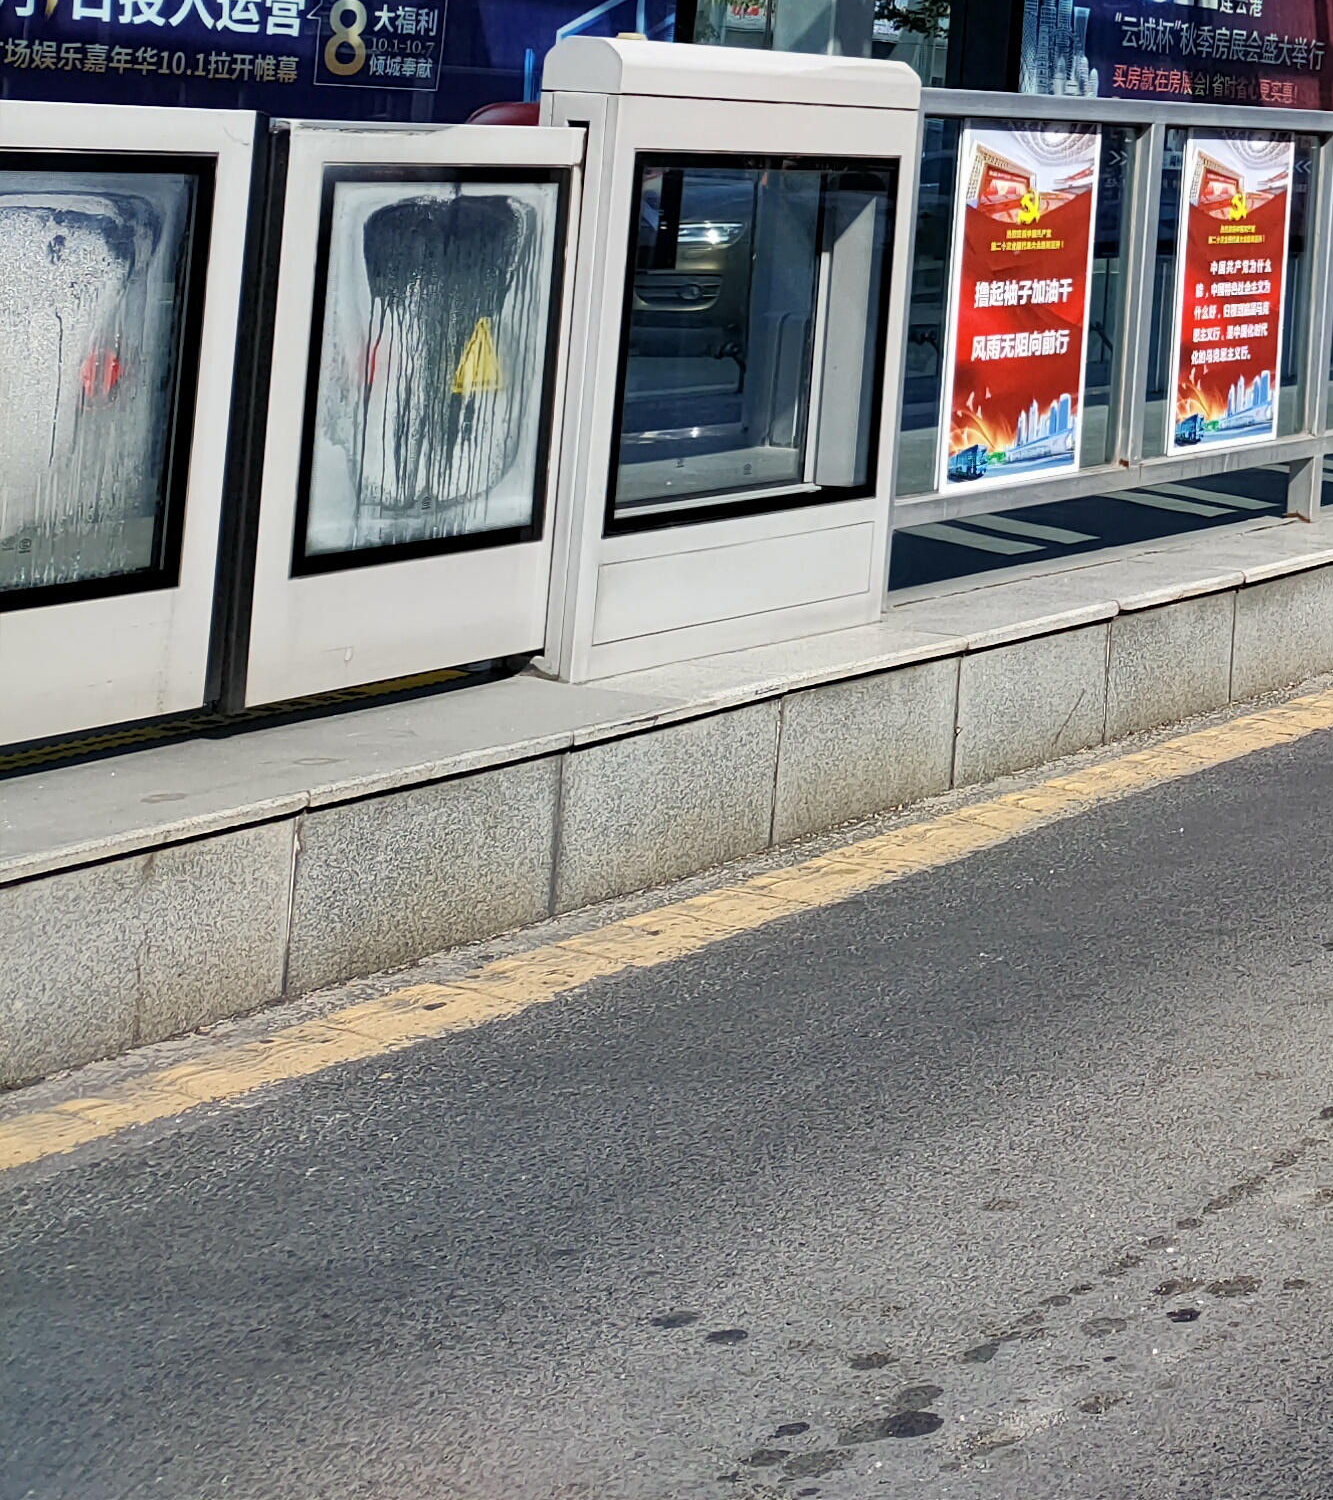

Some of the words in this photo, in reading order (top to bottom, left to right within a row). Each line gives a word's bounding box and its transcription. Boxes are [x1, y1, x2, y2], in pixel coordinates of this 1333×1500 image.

[372, 4, 439, 37] 大福利
[0, 37, 300, 84] 场娱乐嘉年华10.1拉开帷幕
[371, 37, 436, 57] 10.1-10.7
[368, 53, 434, 79] 倾城奉献
[973, 278, 1074, 309] 撸起袖子加油干
[970, 329, 1071, 362] 风雨无阻向前行
